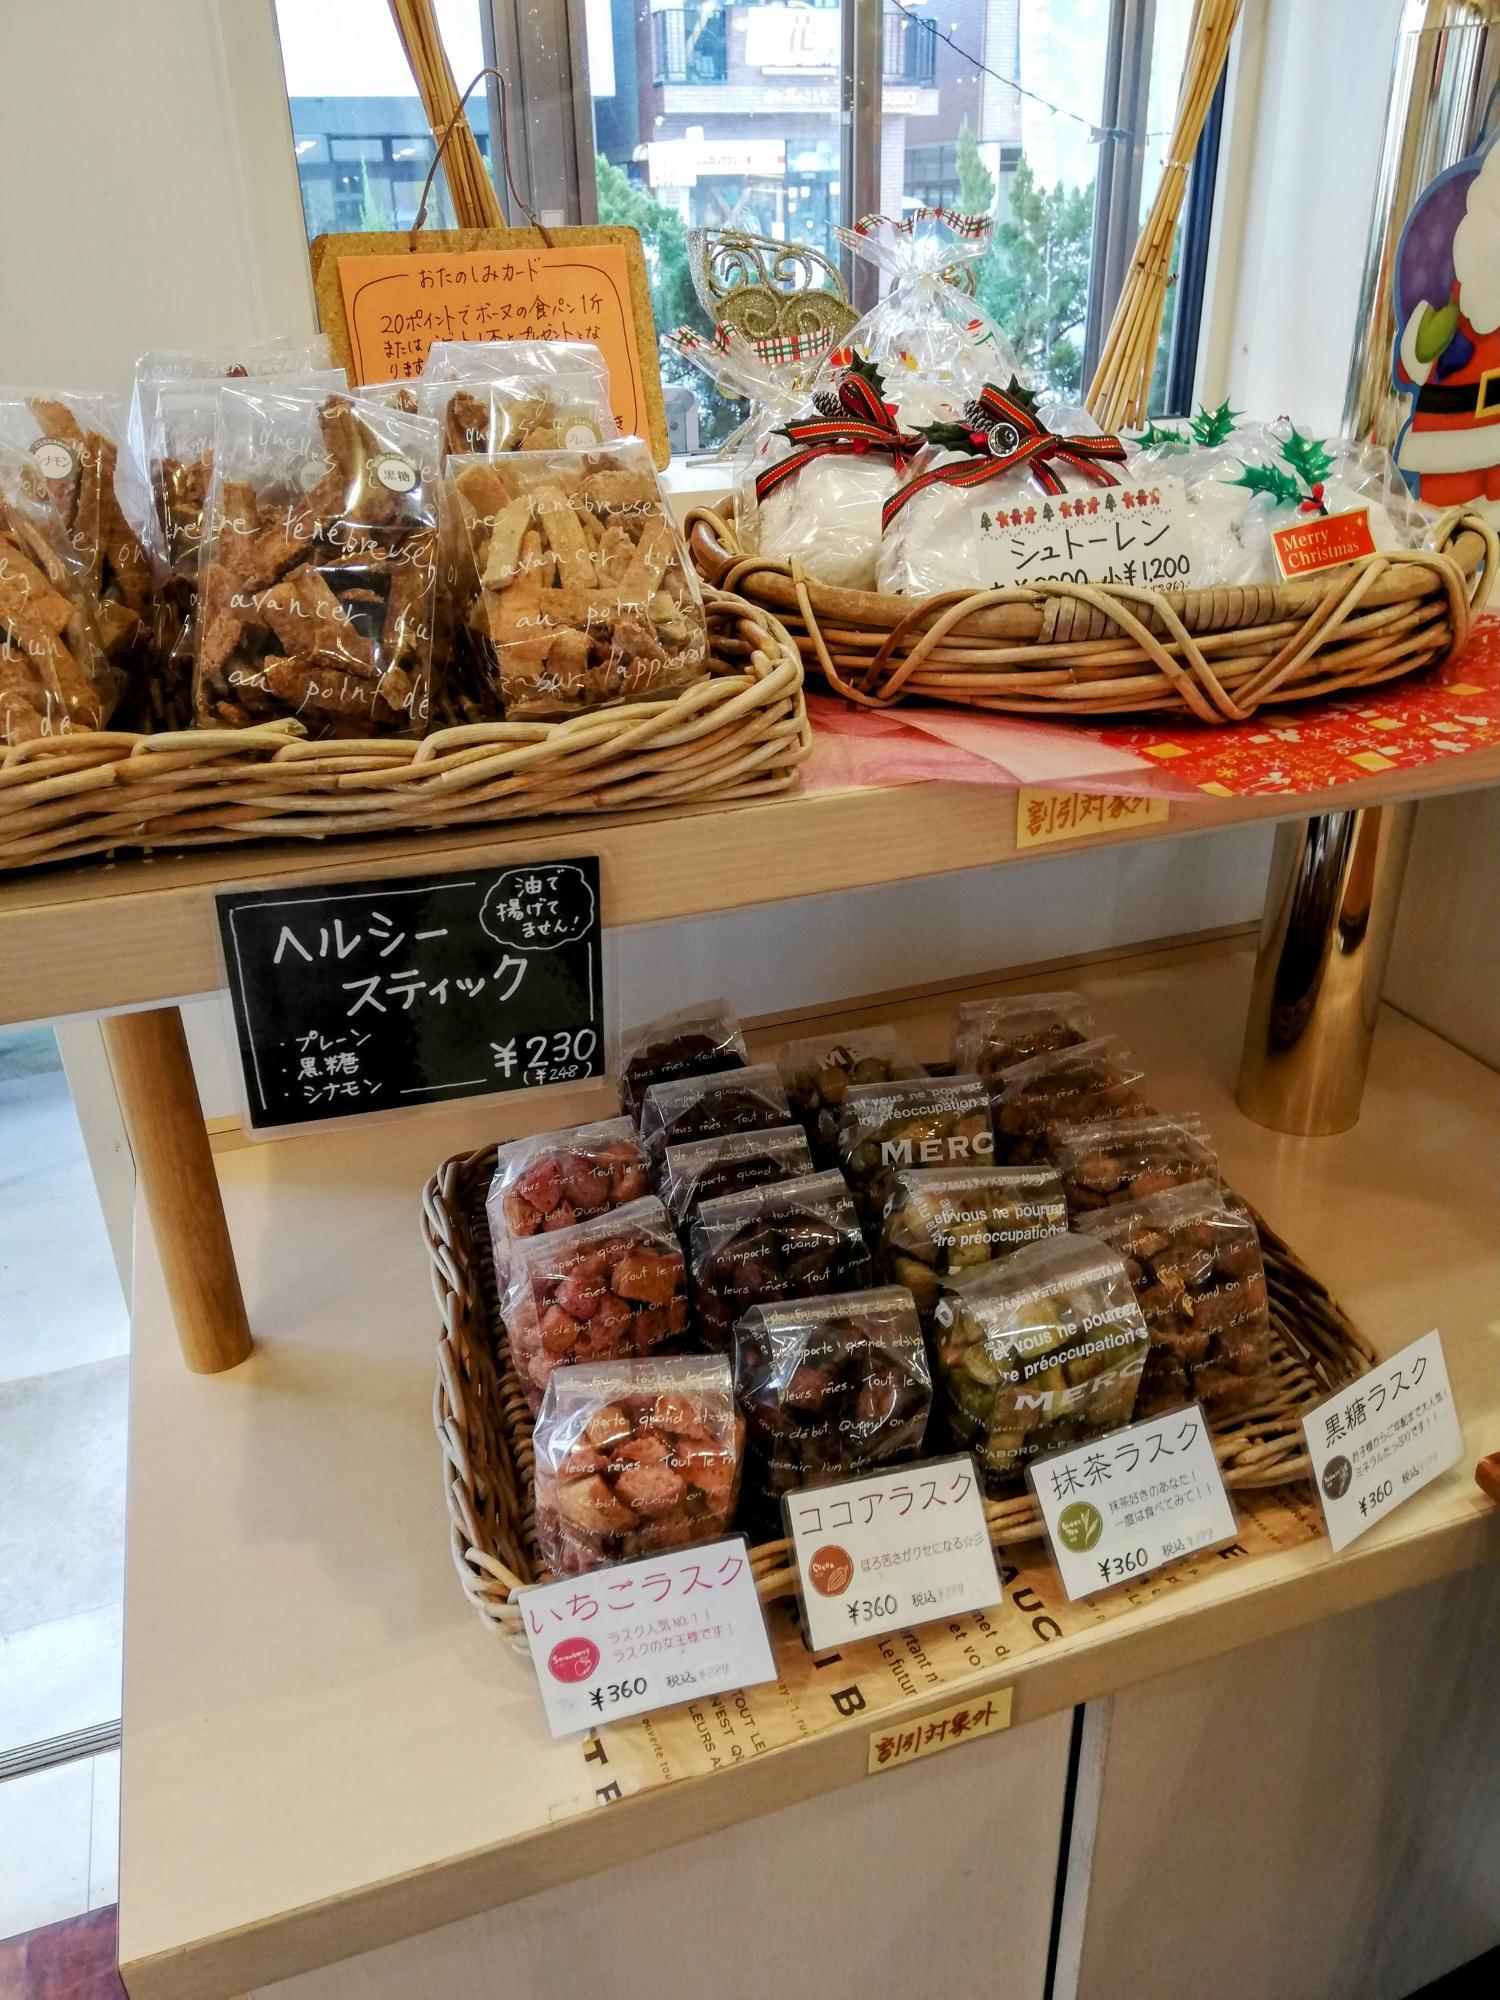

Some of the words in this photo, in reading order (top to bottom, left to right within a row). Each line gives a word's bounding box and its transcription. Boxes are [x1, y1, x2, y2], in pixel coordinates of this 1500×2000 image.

[419, 257, 543, 289] おたのしみカード
[1011, 522, 1171, 571] シュトーレン
[1282, 529, 1329, 552] Merry
[1287, 541, 1361, 569] Christmas
[514, 867, 566, 897] 油で
[495, 897, 560, 922] 揚げて
[521, 916, 581, 940] ません!
[272, 911, 449, 965] ヘルシー
[341, 953, 529, 1018] スティック
[294, 1027, 373, 1053] プレーン
[489, 1027, 598, 1078] ¥230
[296, 1051, 361, 1082] 黒糖
[522, 1061, 593, 1087] (¥248)
[302, 1077, 384, 1105] シナモン
[620, 1269, 648, 1285] Tout
[724, 1284, 749, 1296] leurs
[802, 1268, 831, 1284] Tout
[1058, 1322, 1078, 1339] ne
[1324, 1355, 1428, 1449] 黒糖ラスク
[658, 1454, 692, 1470] Tout
[1050, 1420, 1198, 1501] 抹茶ラスク
[799, 1473, 972, 1536] ココアラスク
[1109, 1470, 1197, 1515] 抹茶好きのあなた!
[1358, 1479, 1394, 1517] ¥360
[1097, 1547, 1150, 1583] ¥360
[1161, 1538, 1186, 1557] 税込
[529, 1555, 744, 1635] いちごラスク
[847, 1593, 898, 1626] ¥360
[911, 1589, 937, 1608] 税込
[551, 1646, 591, 1666] Strawberry
[611, 1623, 734, 1663] ラスクの女王様です!
[876, 1638, 894, 1660] Le
[588, 1677, 648, 1712] ¥360
[665, 1670, 696, 1689] 税込
[688, 1704, 717, 1753] LEURS
[711, 1696, 735, 1737] N'EST
[732, 1689, 756, 1728] TOUT
[750, 1732, 767, 1752] LE
[874, 1699, 1000, 1765] 割引対象外
